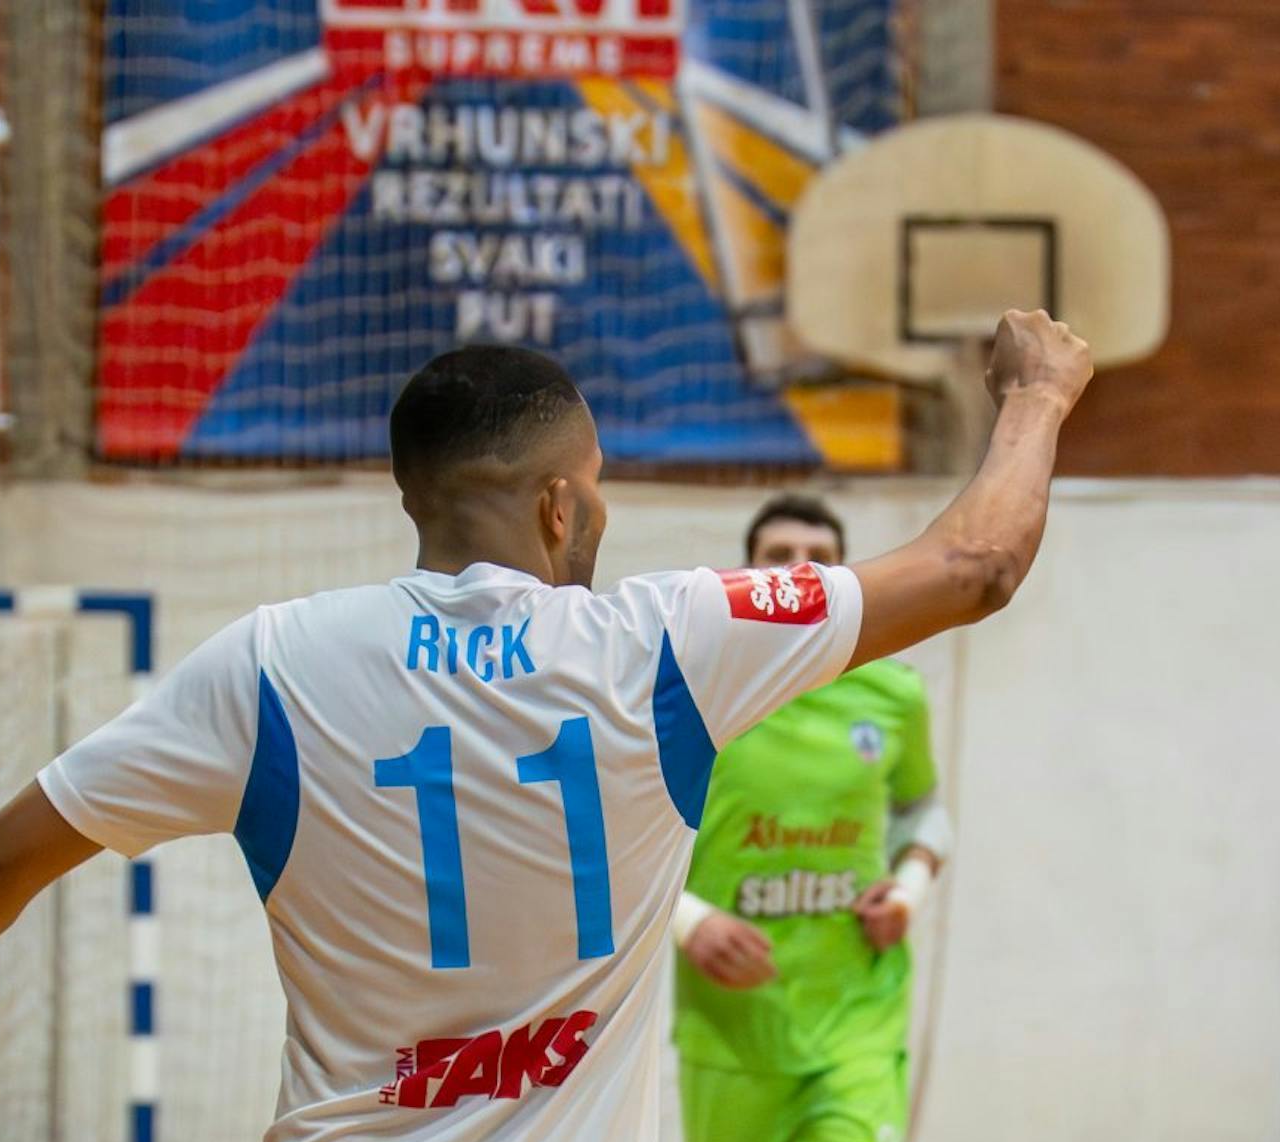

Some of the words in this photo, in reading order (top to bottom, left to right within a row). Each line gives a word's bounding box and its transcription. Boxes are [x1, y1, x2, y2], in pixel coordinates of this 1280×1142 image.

[384, 31, 620, 73] SUPREME
[342, 101, 671, 165] VRHUNSKI
[373, 169, 641, 225] REZULTATI
[430, 231, 586, 283] SVAKI
[455, 292, 557, 341] PUT
[405, 612, 536, 684] RICK
[373, 715, 616, 970] 11
[398, 1008, 599, 1110] FAKS
